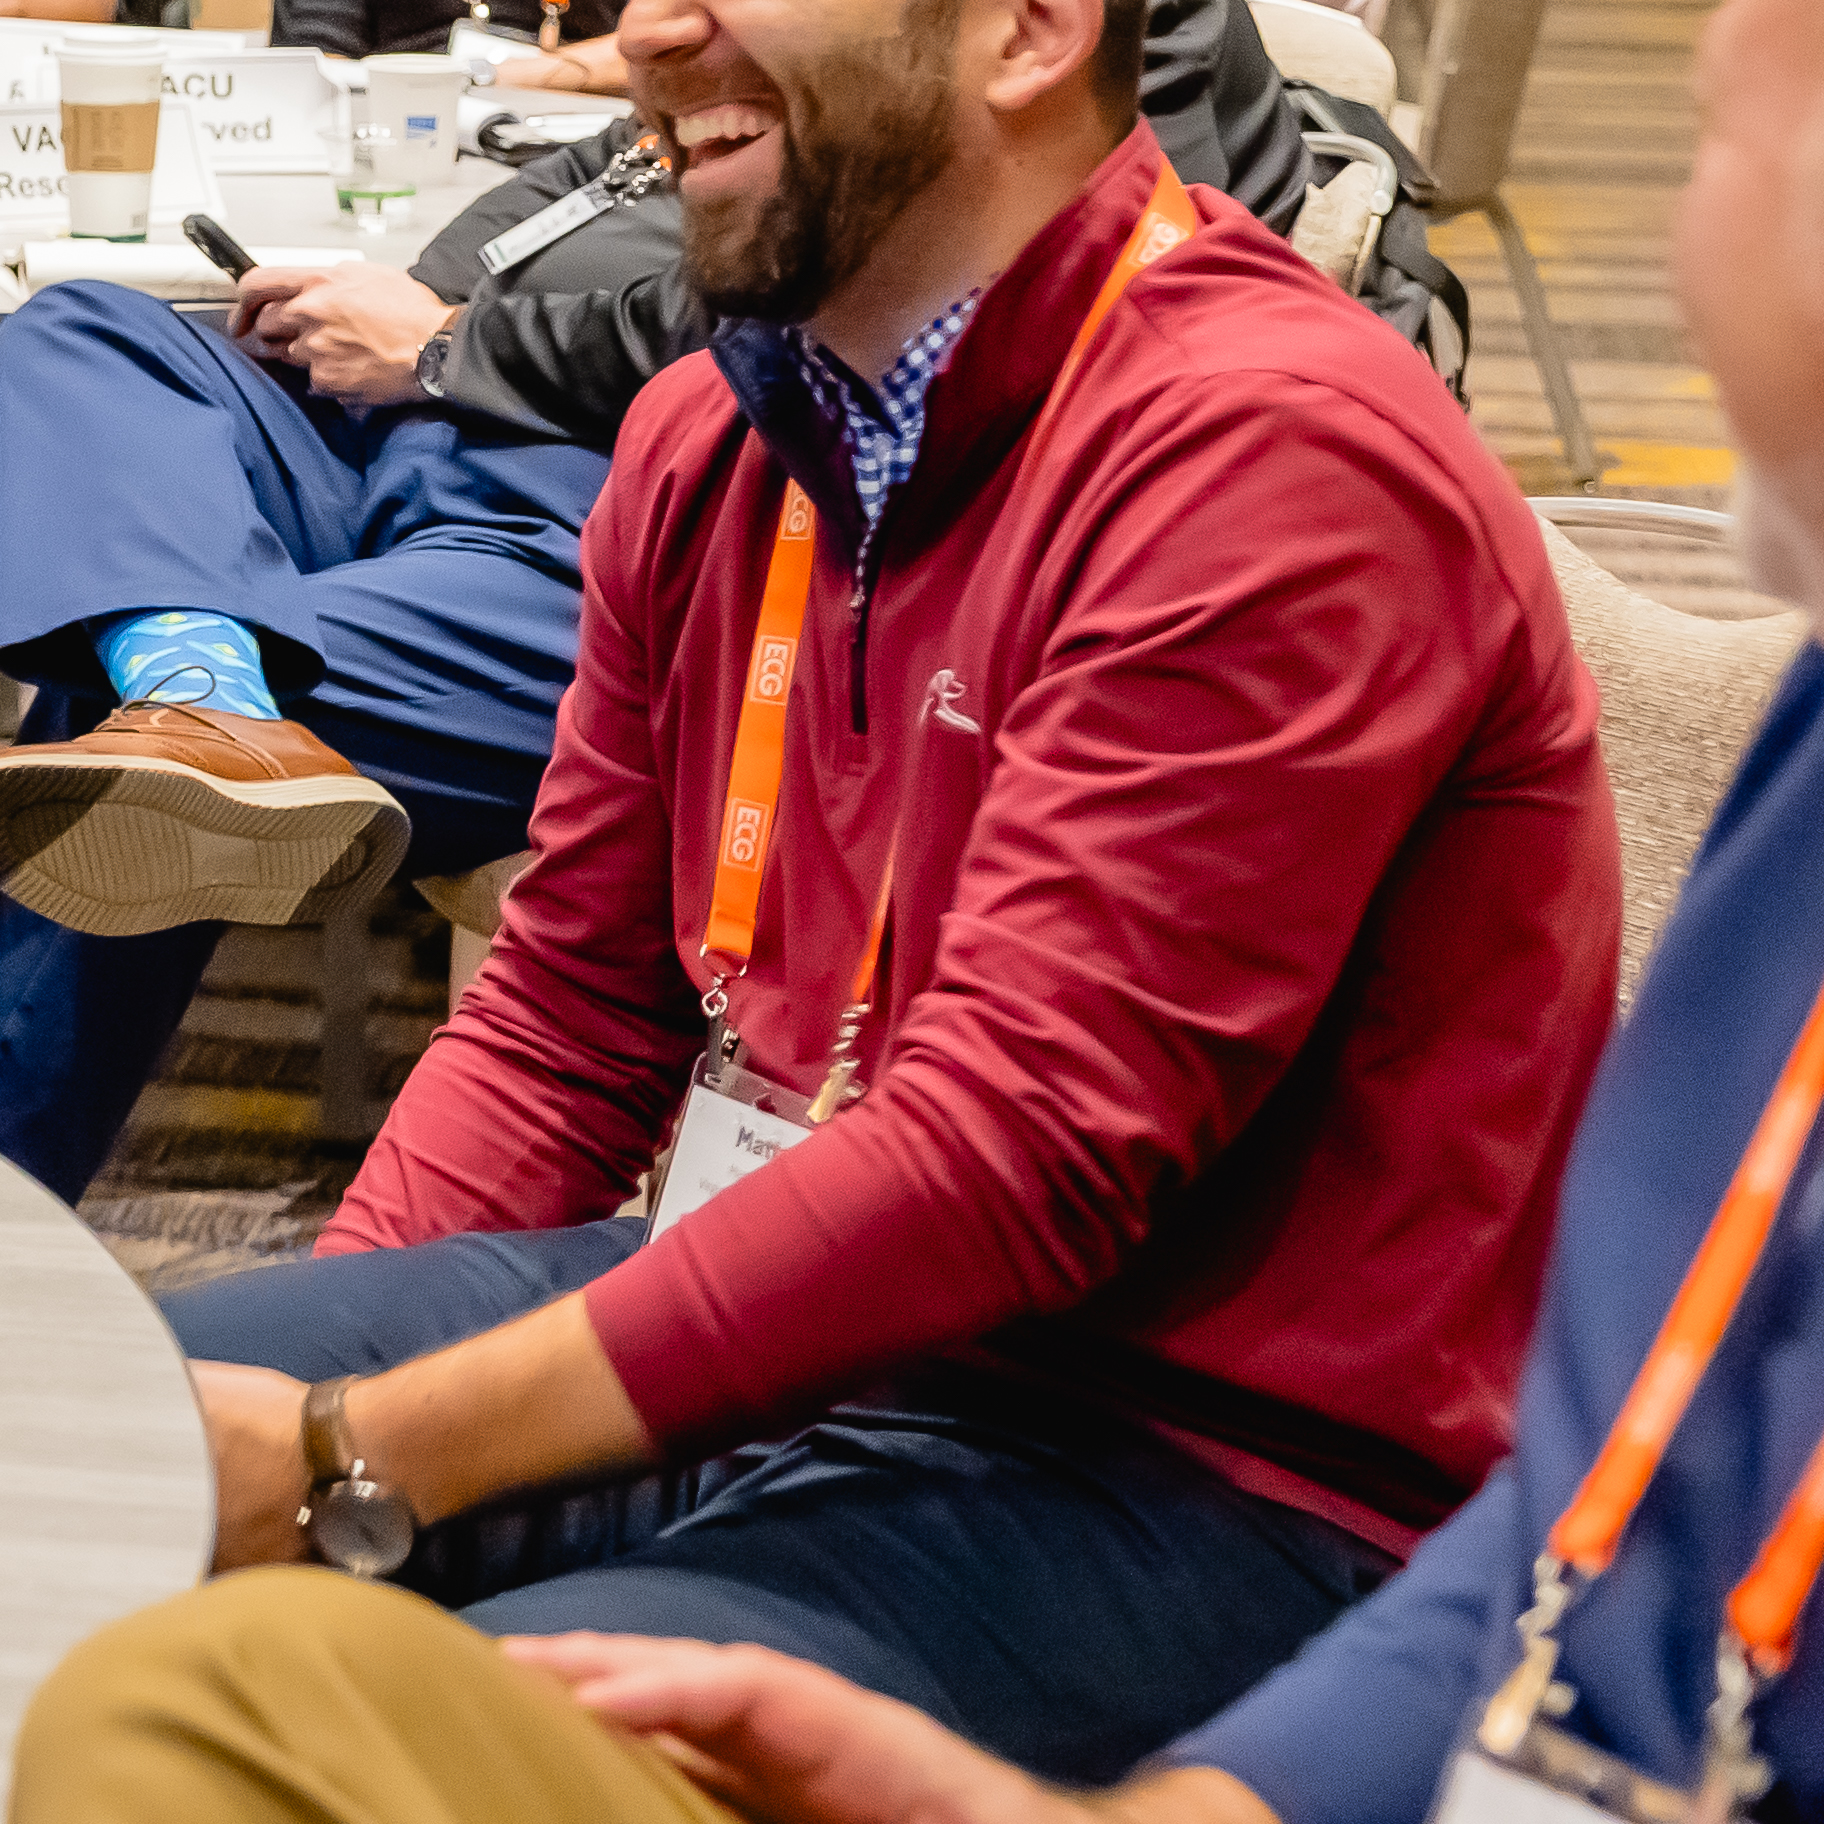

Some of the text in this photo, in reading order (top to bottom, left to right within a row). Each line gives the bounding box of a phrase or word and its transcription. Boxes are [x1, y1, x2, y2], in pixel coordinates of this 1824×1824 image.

[159, 74, 233, 99] ACU
[11, 125, 57, 153] VA
[758, 643, 789, 697] ECG
[731, 806, 761, 862] ECG
